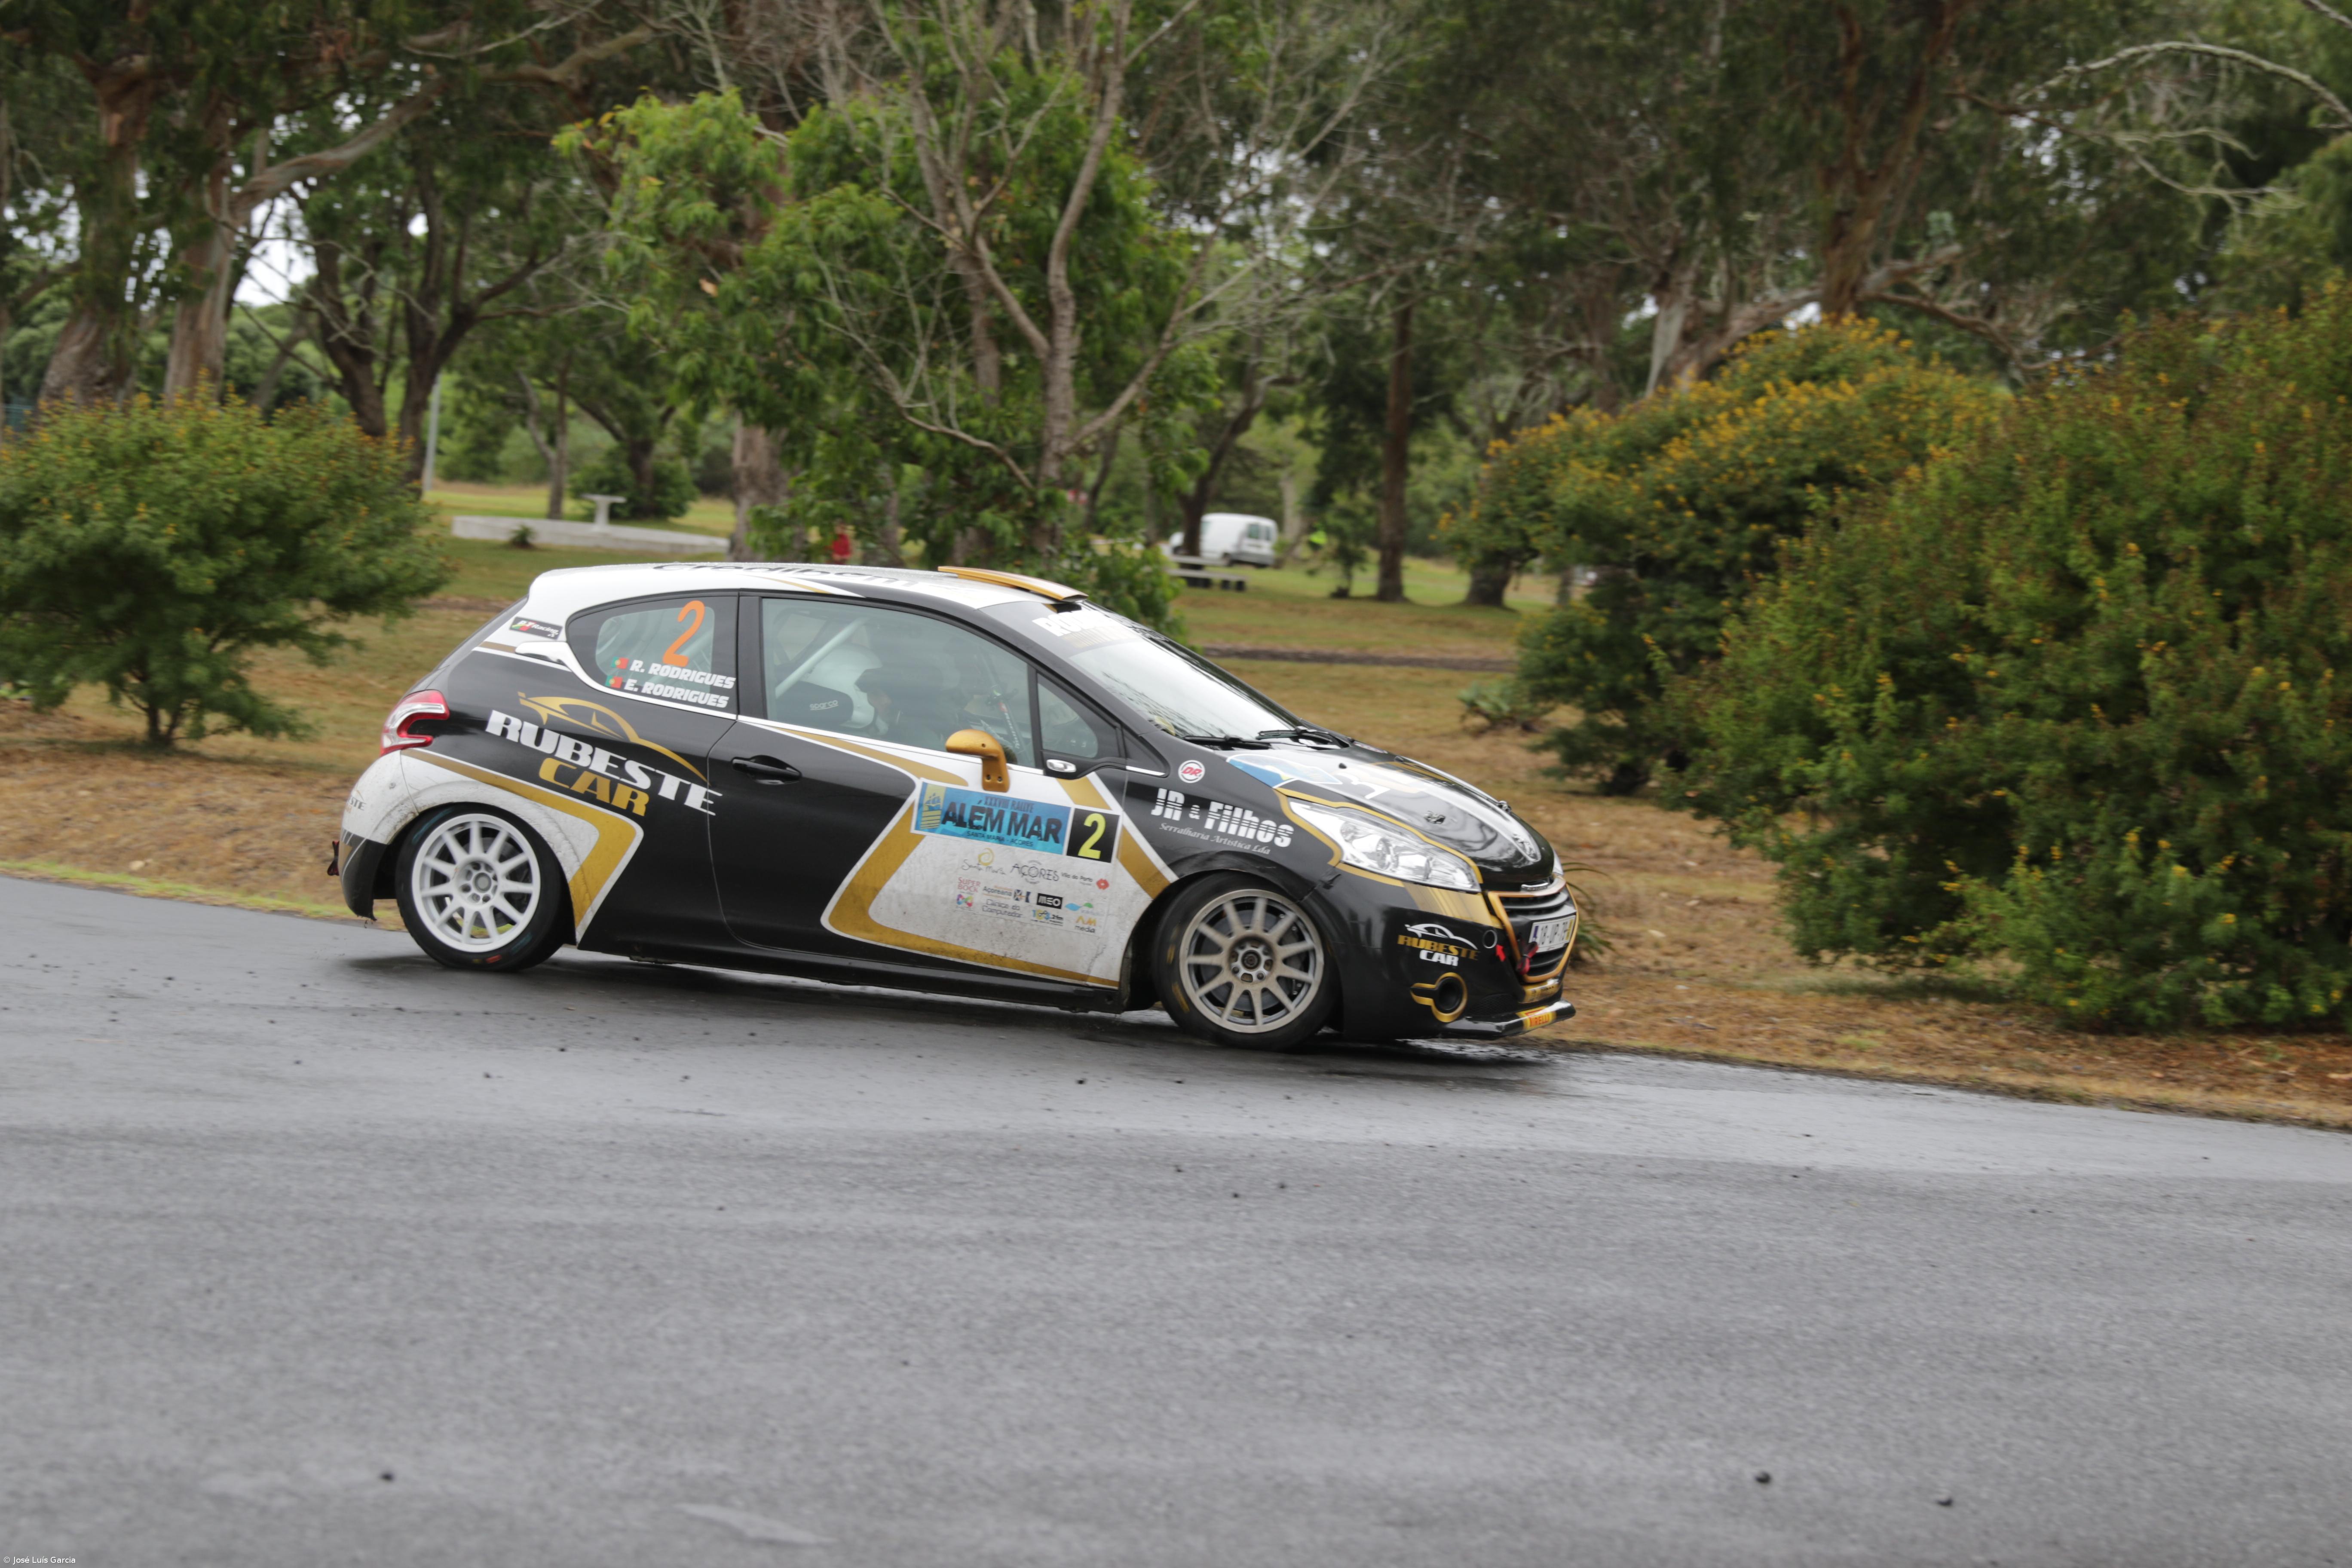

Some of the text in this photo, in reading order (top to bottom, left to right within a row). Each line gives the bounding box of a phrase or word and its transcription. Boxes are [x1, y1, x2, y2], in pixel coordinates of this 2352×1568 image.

[663, 600, 705, 668] 2
[630, 660, 737, 689] R. RODRIGUES
[624, 678, 730, 708] E. RODRIGUES
[809, 700, 839, 710] sparco
[485, 709, 723, 816] RUBESTE
[539, 757, 649, 817] CAR
[941, 799, 1063, 844] ALÉM MAR
[1151, 788, 1295, 848] JR & Filhos
[1078, 813, 1106, 859] 2
[1159, 823, 1210, 840] Serralharia
[1252, 845, 1271, 855] Lda
[958, 877, 981, 887] SUPER
[1010, 864, 1060, 881] AÇORES
[958, 884, 978, 893] BOCK
[1038, 895, 1061, 907] MEO
[1397, 934, 1481, 961] RUBESTE
[1419, 949, 1459, 967] CAR
